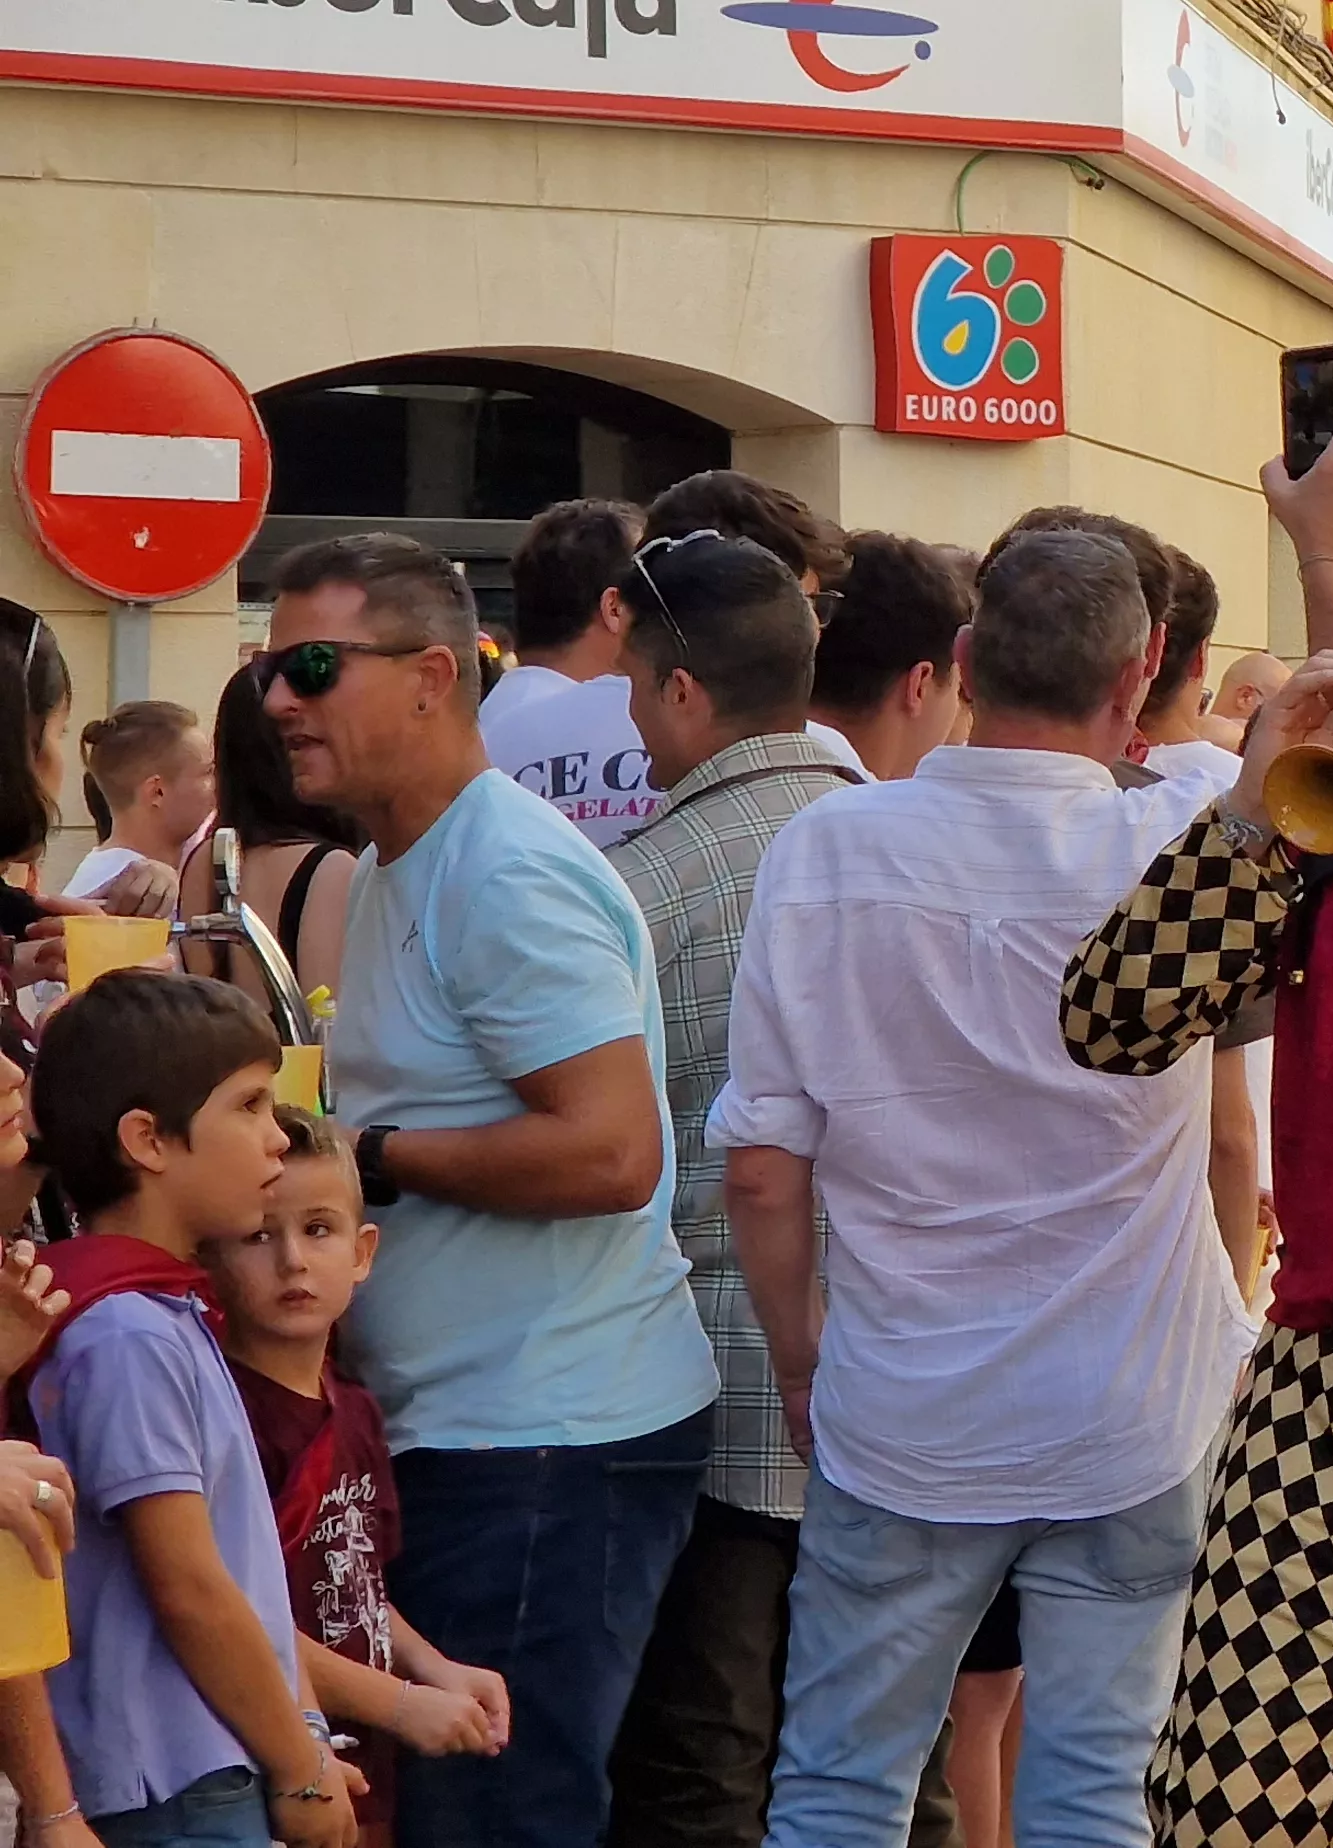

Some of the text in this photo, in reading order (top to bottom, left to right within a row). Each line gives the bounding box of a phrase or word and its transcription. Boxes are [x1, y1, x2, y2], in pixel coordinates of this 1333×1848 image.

[905, 394, 1057, 426] EURO 6000
[512, 751, 589, 800] CE
[558, 797, 662, 820] GELAT
